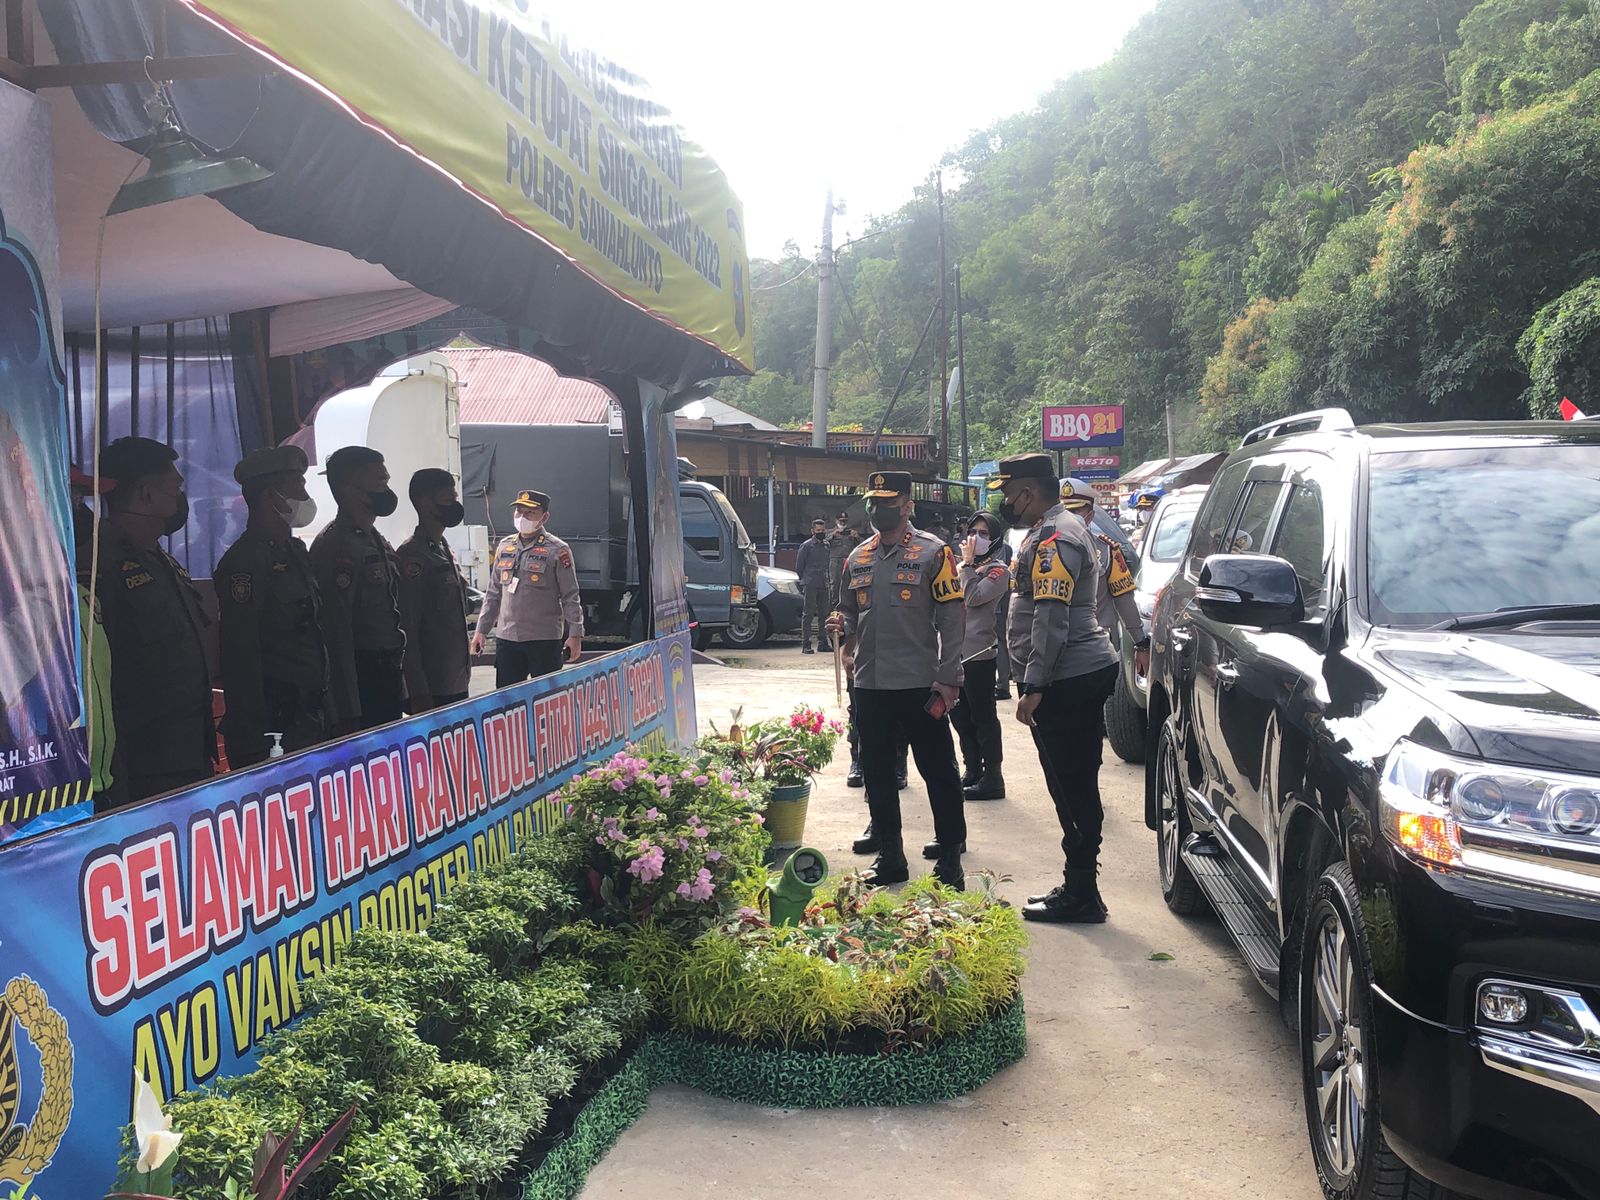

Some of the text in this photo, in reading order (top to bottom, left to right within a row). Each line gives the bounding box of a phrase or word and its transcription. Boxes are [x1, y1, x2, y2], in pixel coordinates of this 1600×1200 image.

[487, 8, 592, 176] KETUPAT
[597, 122, 692, 265] SINGGALANG
[693, 222, 722, 290] 2022
[506, 121, 664, 296] POLRES SAWAHLUNTO
[1050, 412, 1117, 442] BBQ 21
[1076, 457, 1114, 466] RESTO
[896, 562, 921, 571] POLRI
[933, 580, 952, 599] KA
[1051, 578, 1070, 599] RES
[28, 741, 58, 763] S.I.K.
[83, 786, 315, 1007] SELAMAT
[319, 753, 410, 888] HARI
[405, 723, 488, 844] RAYA
[482, 704, 537, 806] IDUL
[534, 687, 575, 779] FITRI
[574, 675, 612, 758] 1443
[609, 669, 623, 738] H
[628, 657, 658, 728] 2022
[131, 985, 219, 1123] AYO
[225, 908, 352, 1053] VAKSIN
[473, 818, 511, 869] DAN
